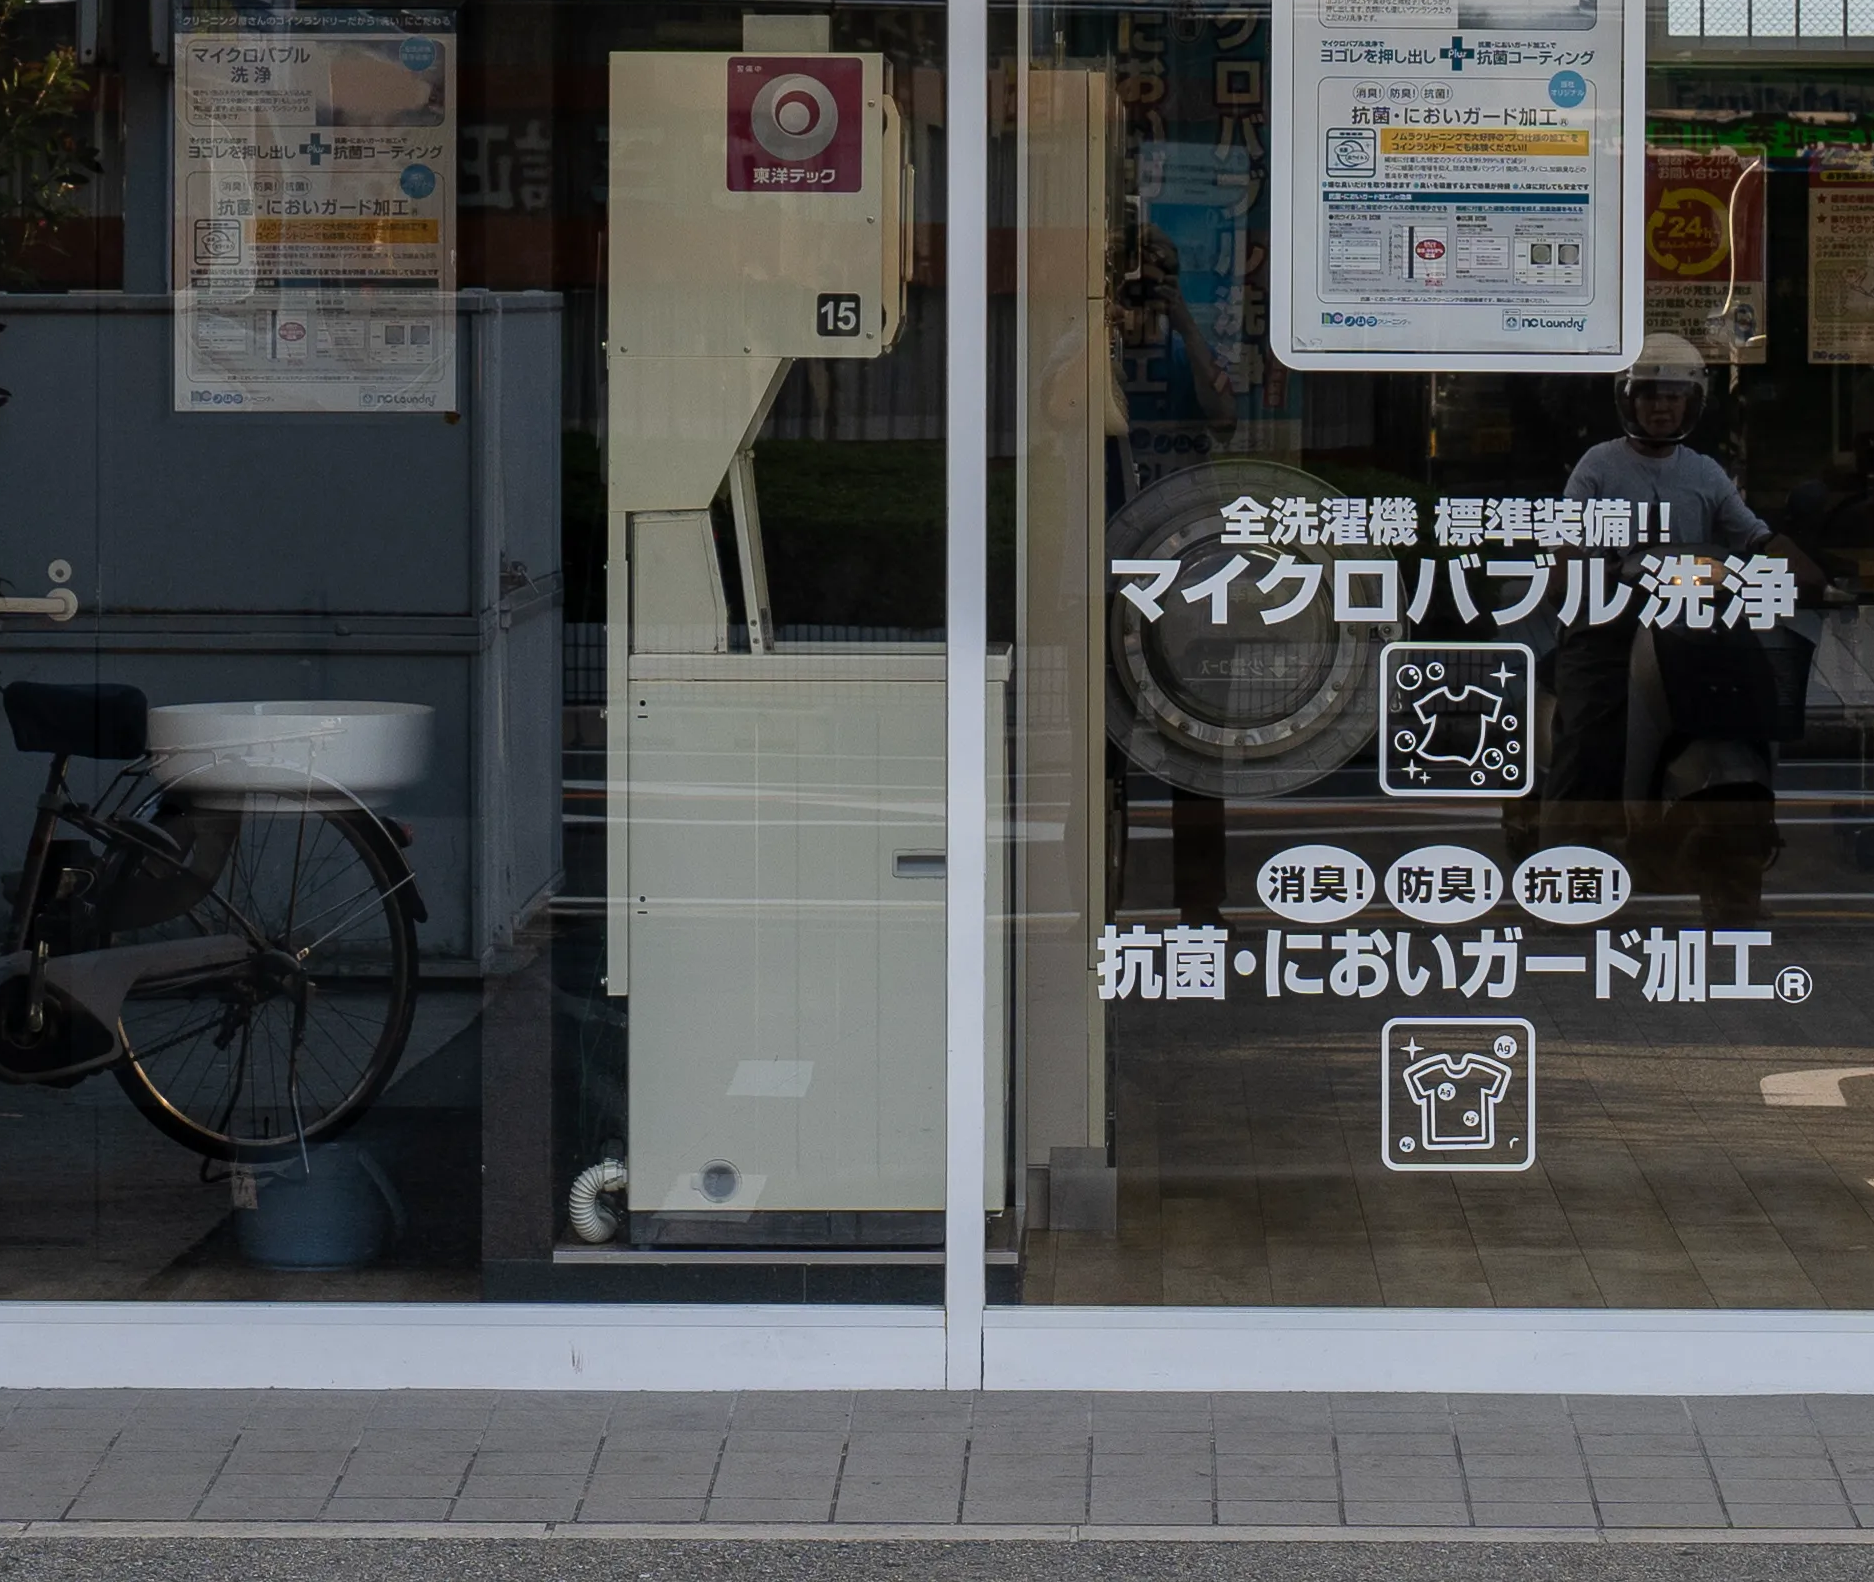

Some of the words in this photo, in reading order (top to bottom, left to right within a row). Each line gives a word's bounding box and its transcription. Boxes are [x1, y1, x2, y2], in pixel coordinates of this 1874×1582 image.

[191, 47, 311, 64] マイクロバブル
[1320, 48, 1437, 65] ヨゴレを押し出し
[1477, 49, 1596, 66] 抗菌コーティング
[333, 145, 443, 160] 抗菌コーティング
[753, 167, 836, 185] 東洋テック
[820, 300, 858, 330] 15
[1220, 496, 1418, 547] 全洗濯機
[1433, 496, 1673, 547] 標準装備!!
[1110, 553, 1799, 630] マイクロバブル洗浄
[1268, 864, 1366, 905] 消臭!
[1395, 864, 1494, 905] 防臭!
[1524, 864, 1623, 906] 抗菌!
